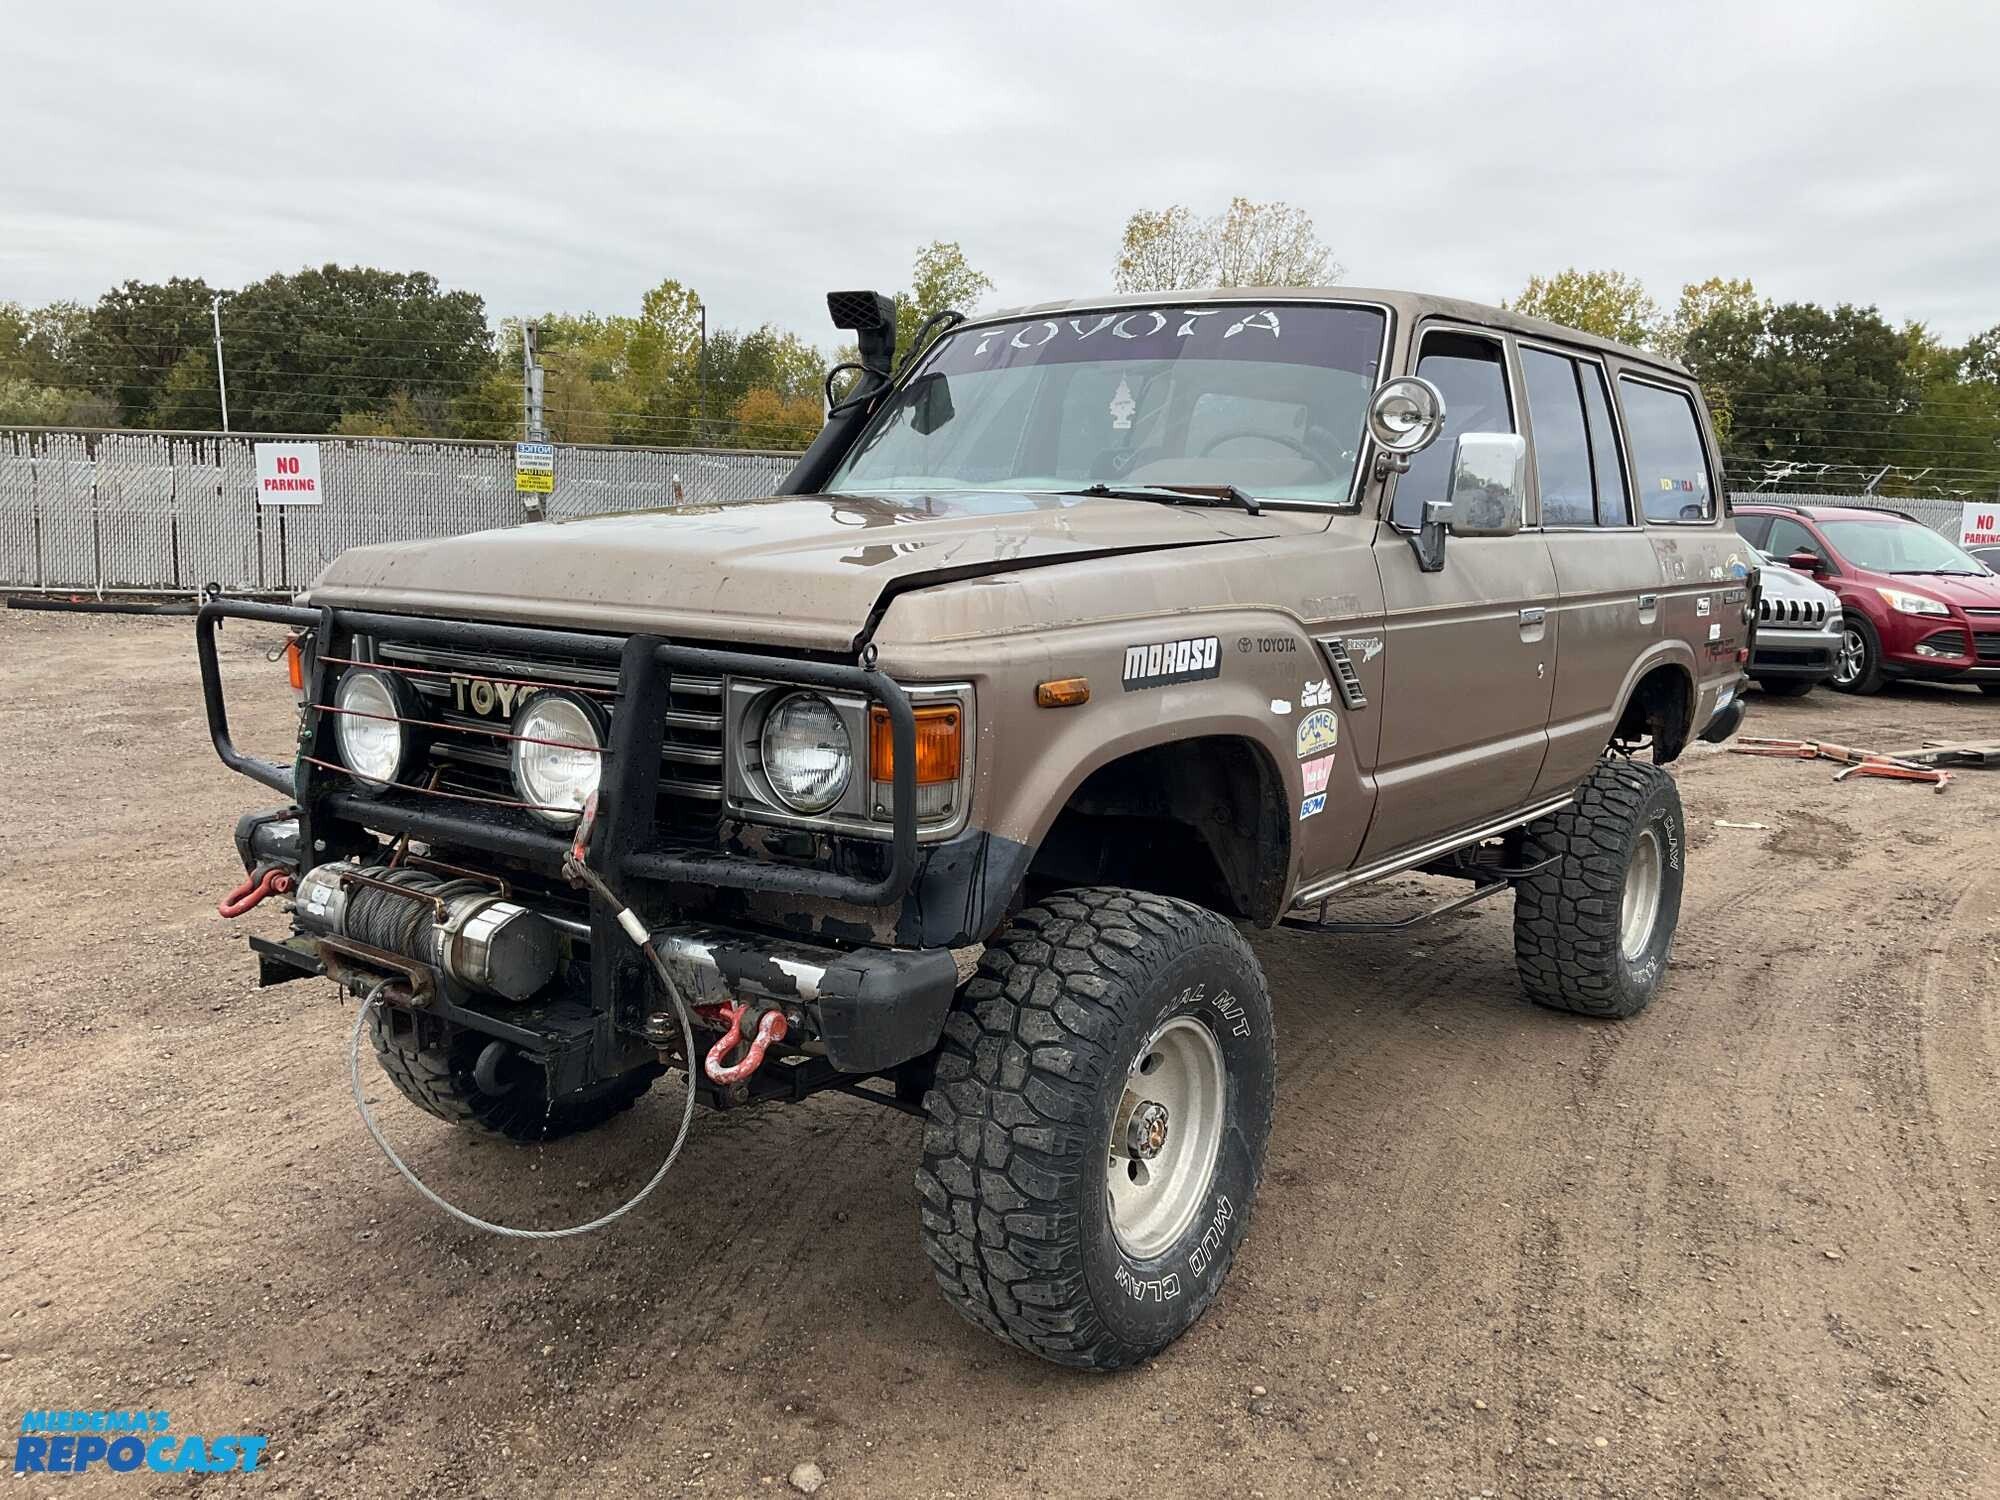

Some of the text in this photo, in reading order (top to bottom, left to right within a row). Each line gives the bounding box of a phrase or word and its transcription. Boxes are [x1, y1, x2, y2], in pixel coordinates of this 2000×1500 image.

[973, 308, 1281, 356] TOYOTA
[276, 456, 300, 474] NO
[264, 478, 315, 491] PARKING
[1976, 513, 1994, 531] NO
[1122, 636, 1220, 681] MOROSO
[1256, 637, 1297, 653] TOYOTA
[450, 676, 541, 718] TOY
[1300, 713, 1335, 742] CAMEL
[1114, 1195, 1235, 1303] MUD CLAW
